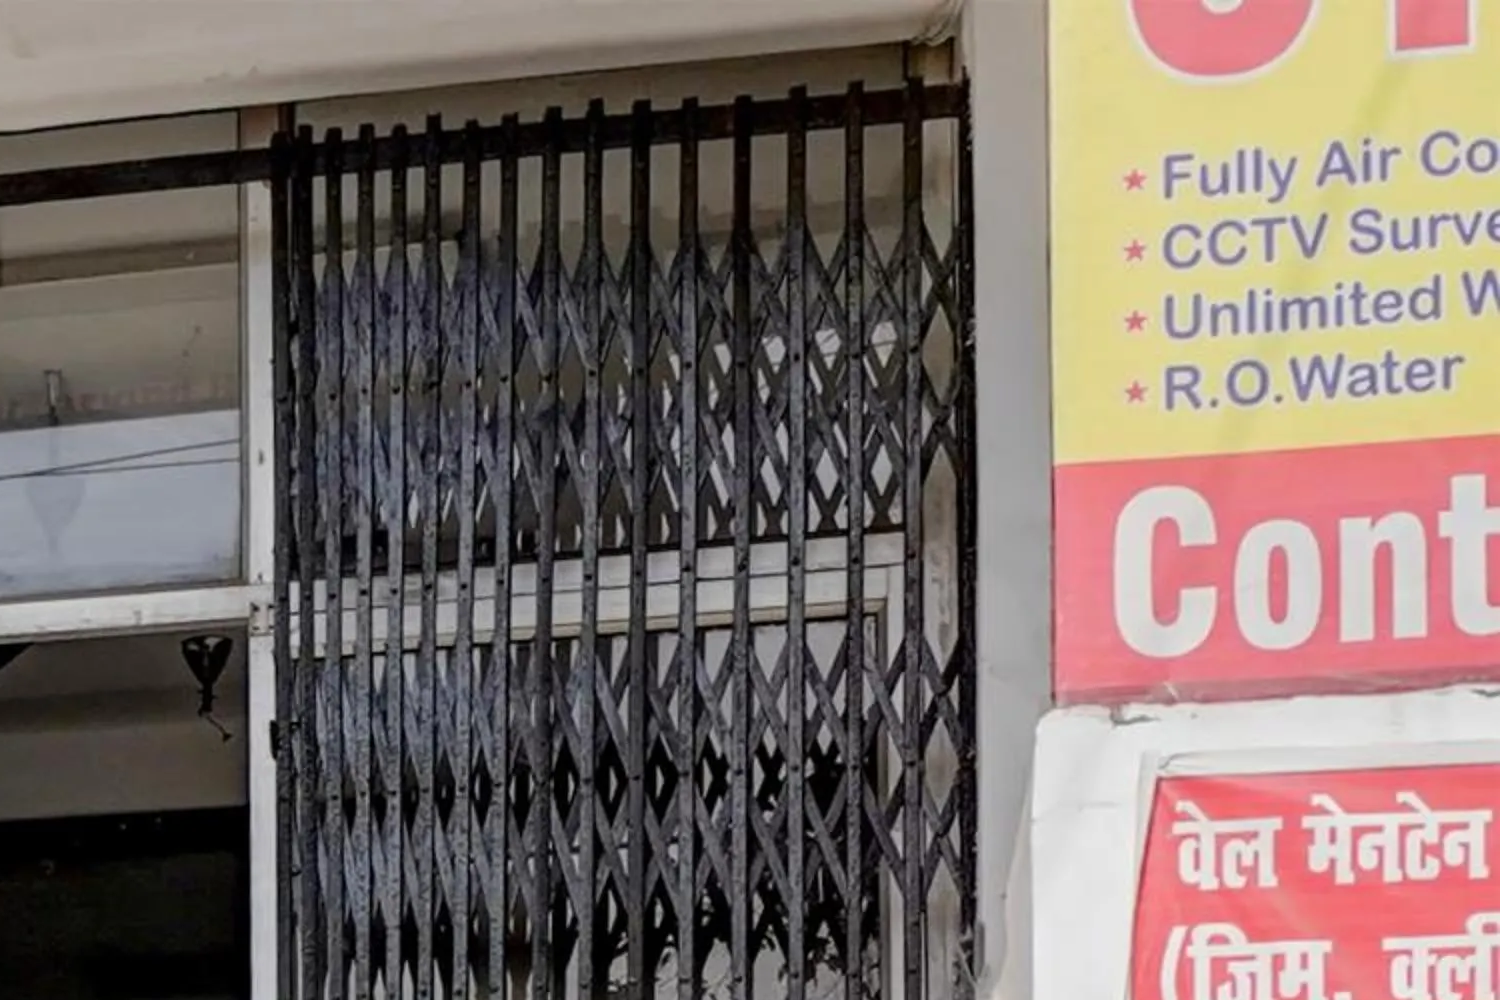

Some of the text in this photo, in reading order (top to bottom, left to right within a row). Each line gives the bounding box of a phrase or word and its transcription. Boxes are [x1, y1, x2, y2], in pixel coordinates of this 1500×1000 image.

[1162, 130, 1500, 204] Fully Air Co
[1162, 213, 1328, 270] CCTV
[1163, 275, 1442, 339] Unlimited
[1163, 351, 1465, 411] R.O.Water
[1113, 473, 1500, 658] Cont
[1172, 791, 1493, 890] वेल मेनटेन
